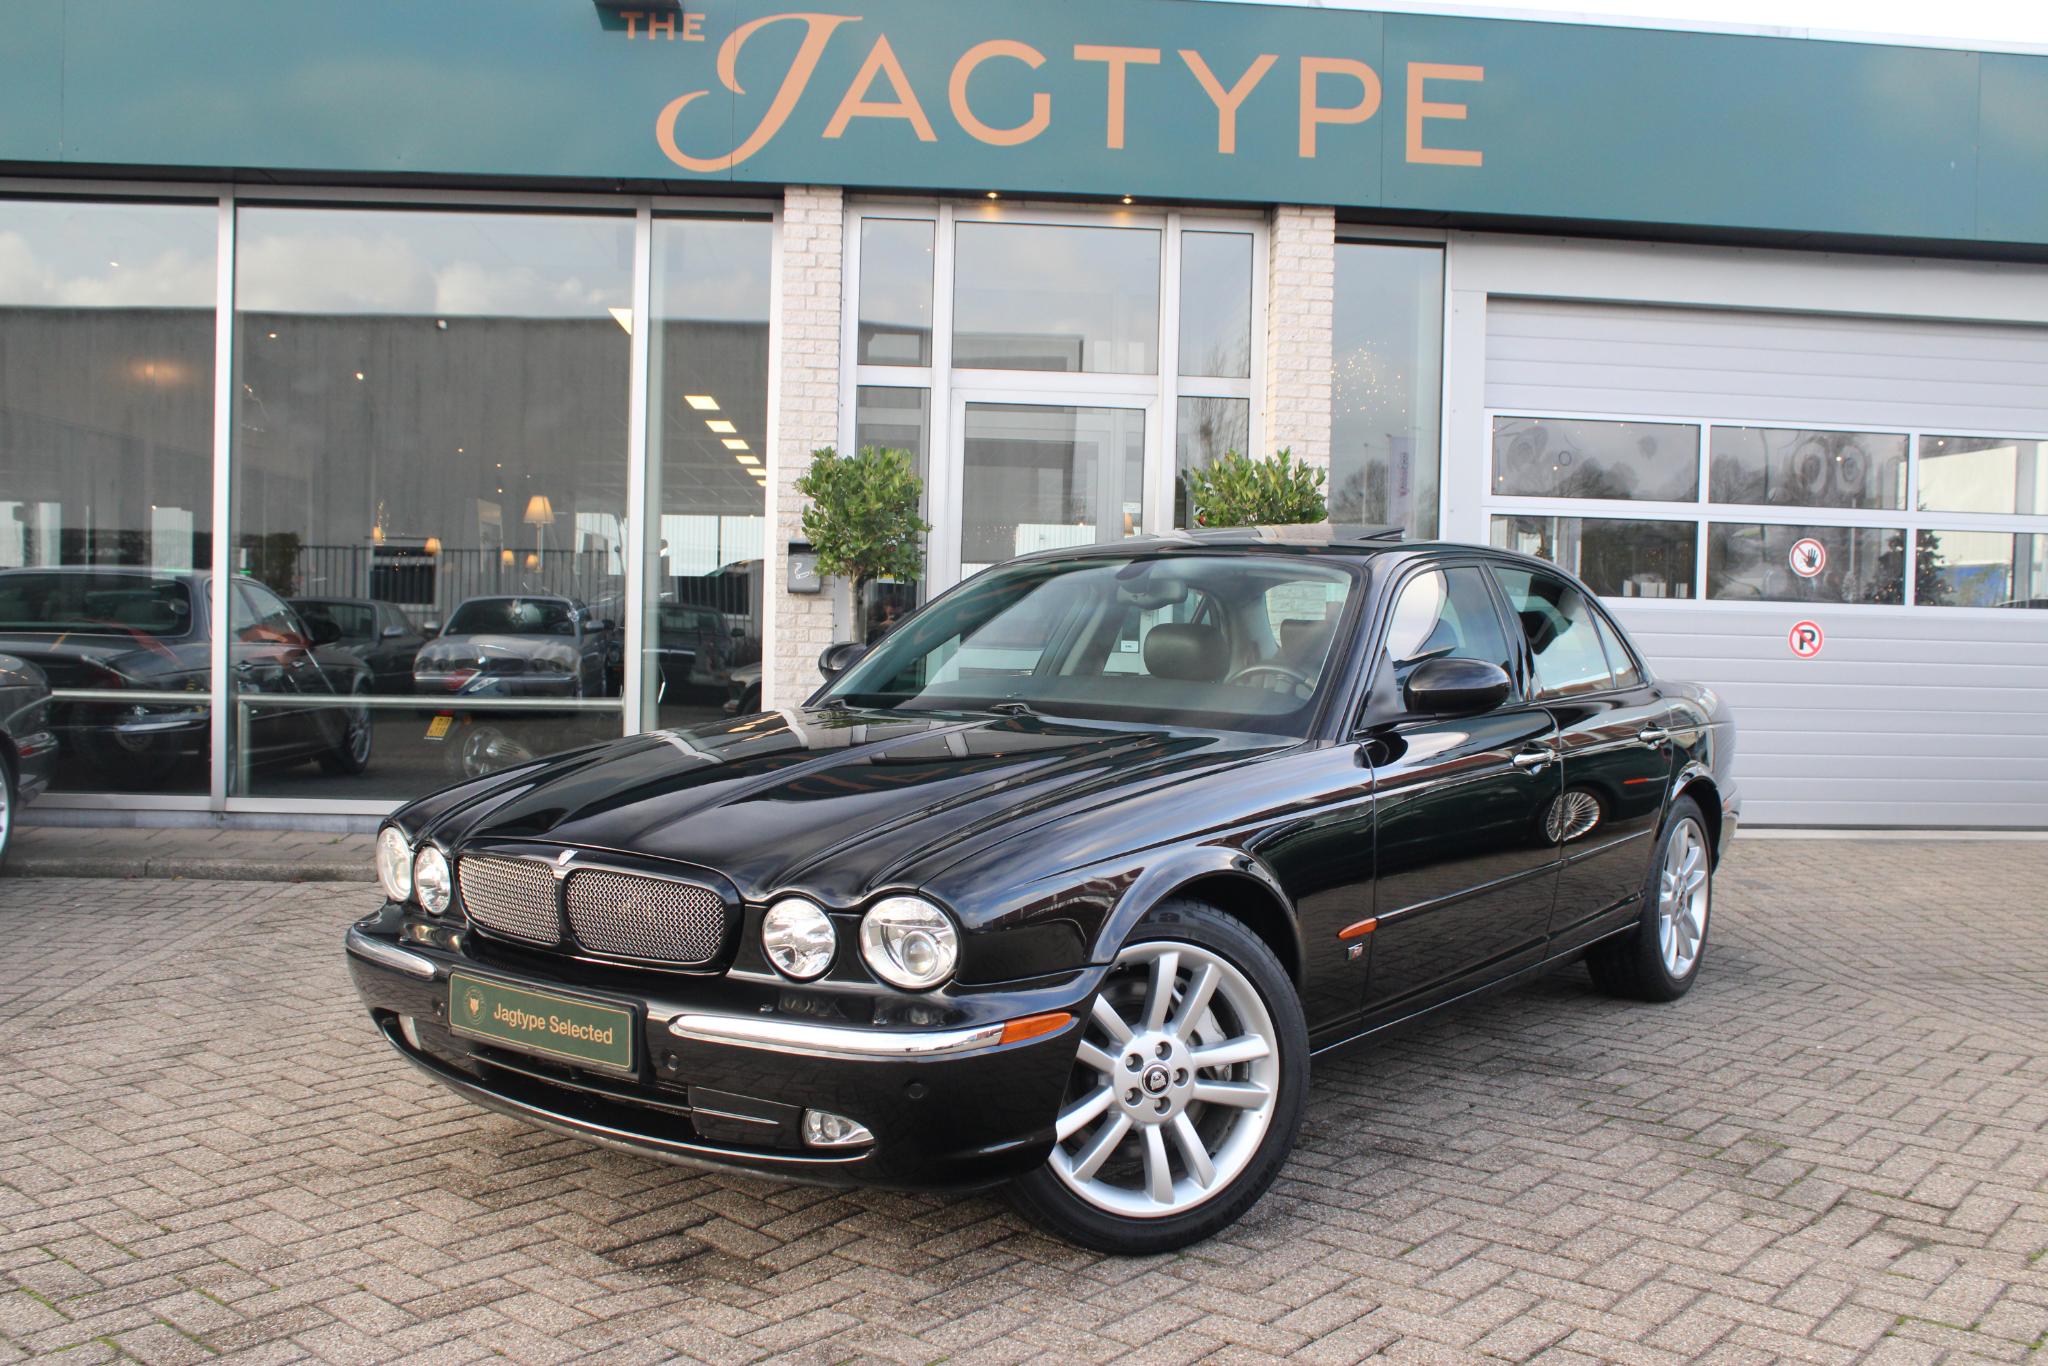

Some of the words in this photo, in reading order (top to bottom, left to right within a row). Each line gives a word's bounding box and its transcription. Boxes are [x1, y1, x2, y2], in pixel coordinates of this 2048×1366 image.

[620, 11, 705, 41] THE
[656, 13, 1484, 172] JAGTYPE
[1799, 629, 1816, 650] P
[493, 1003, 546, 1032] Jagtype
[549, 1015, 613, 1045] Selected
